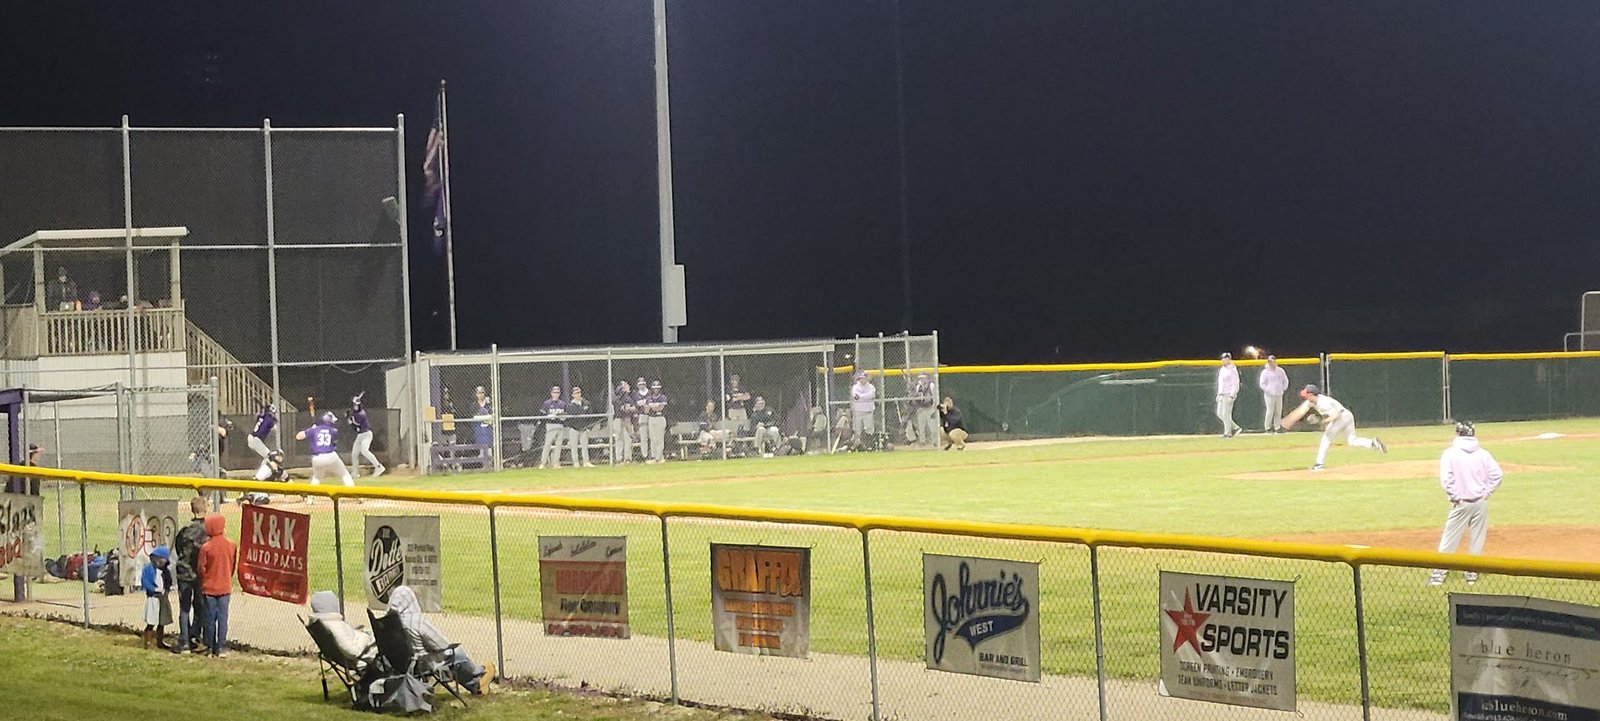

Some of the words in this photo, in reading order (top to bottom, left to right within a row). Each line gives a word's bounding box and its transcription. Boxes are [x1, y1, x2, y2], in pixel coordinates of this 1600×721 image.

[317, 433, 332, 447] 33
[252, 511, 266, 546] K
[268, 514, 281, 549] &
[284, 517, 297, 552] K
[246, 547, 271, 565] AUTO
[273, 552, 303, 571] PARTS
[931, 561, 1024, 664] Johnnie's
[1195, 583, 1288, 619] VARSITY
[969, 620, 994, 637] WEST
[1200, 623, 1290, 660] SPORTS
[1480, 639, 1515, 657] blue
[1526, 642, 1571, 664] heron
[979, 652, 995, 662] BAR
[996, 654, 1009, 665] AND
[1010, 656, 1028, 667] GRILL
[1179, 660, 1202, 673] SCREEN
[1203, 664, 1231, 677] PRINTING
[1250, 682, 1278, 696] JACKETS
